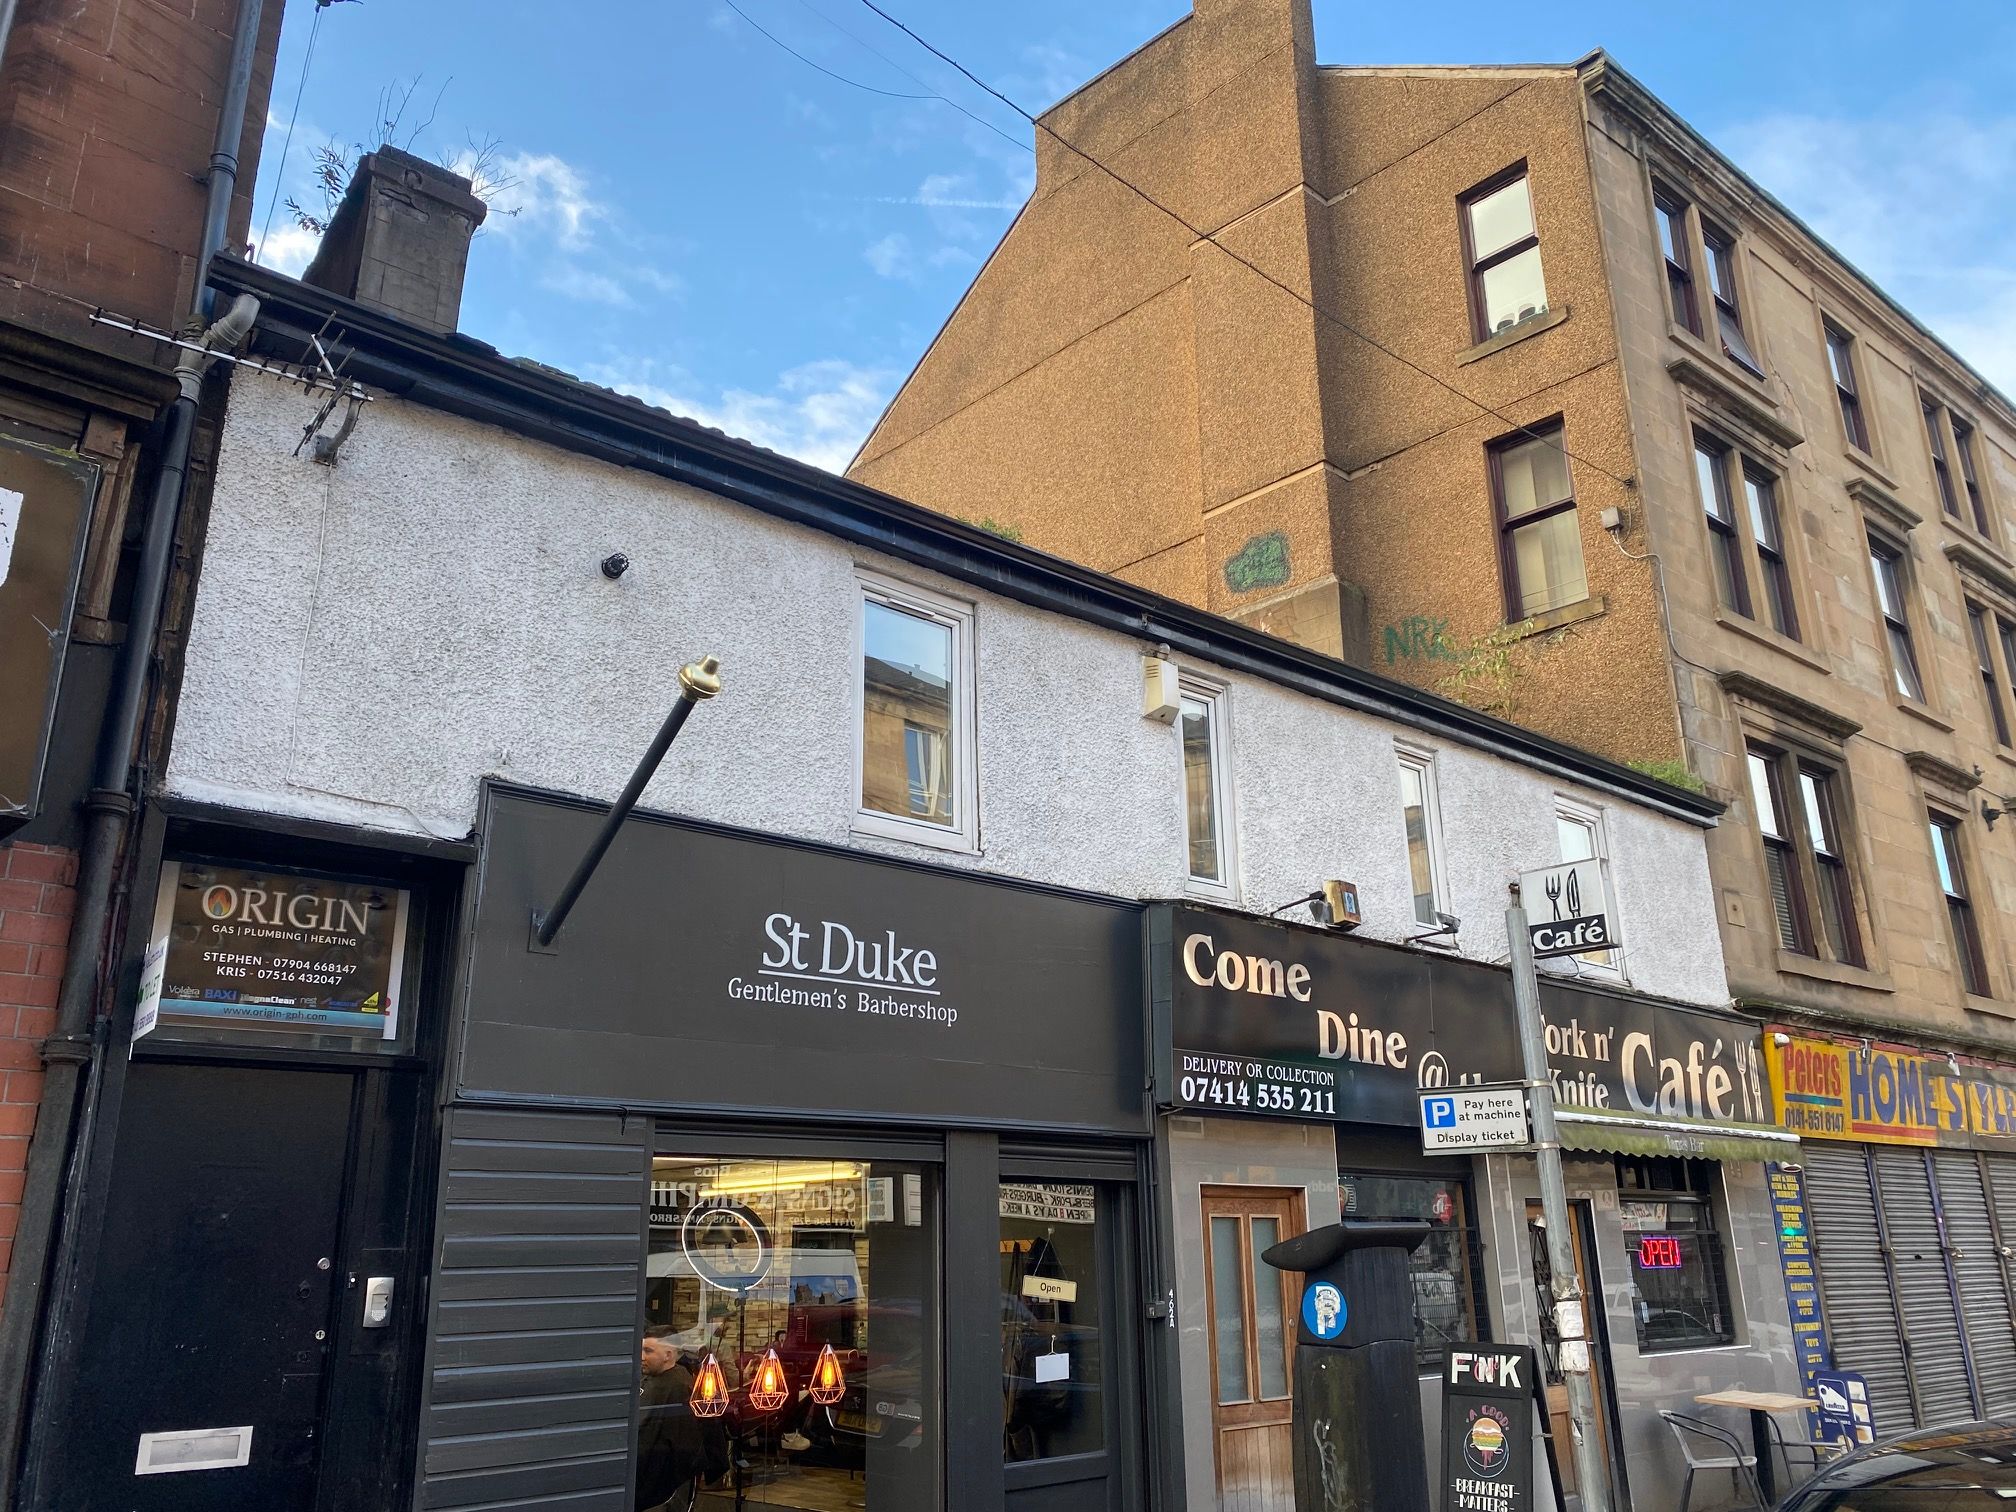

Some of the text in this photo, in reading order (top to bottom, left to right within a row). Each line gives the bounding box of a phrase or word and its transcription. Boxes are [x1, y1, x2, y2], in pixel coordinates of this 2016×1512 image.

[202, 884, 372, 935] ORIGIN
[212, 924, 357, 947] GAS PLUMBING HEATING
[762, 913, 937, 987] St Duke
[1533, 919, 1604, 951] Café
[203, 951, 357, 974] STEPHEN 07904 668147
[216, 966, 342, 986] KRIS 07516 432047
[1183, 933, 1312, 1002] Come
[204, 988, 237, 1000] BAXI
[728, 977, 958, 1027] Gentlemen's Barbershop
[223, 1005, 328, 1022] www.origin-gph.com
[1317, 1009, 1408, 1069] Dine
[1541, 1014, 1614, 1062] ork n'
[1183, 1056, 1335, 1087] DELIVERY OR COLLECTION
[1621, 1032, 1735, 1122] Café
[1784, 1042, 1842, 1097] Peters
[1180, 1075, 1337, 1115] 07414 535 211
[1464, 1098, 1513, 1110] Pay here
[1547, 1068, 1610, 1109] Knife
[1848, 1050, 1938, 1127] HOME
[1458, 1109, 1521, 1121] at machine
[1437, 1129, 1516, 1144] Display ticket
[1641, 1240, 1680, 1266] OPEN
[1040, 1282, 1061, 1294] Open
